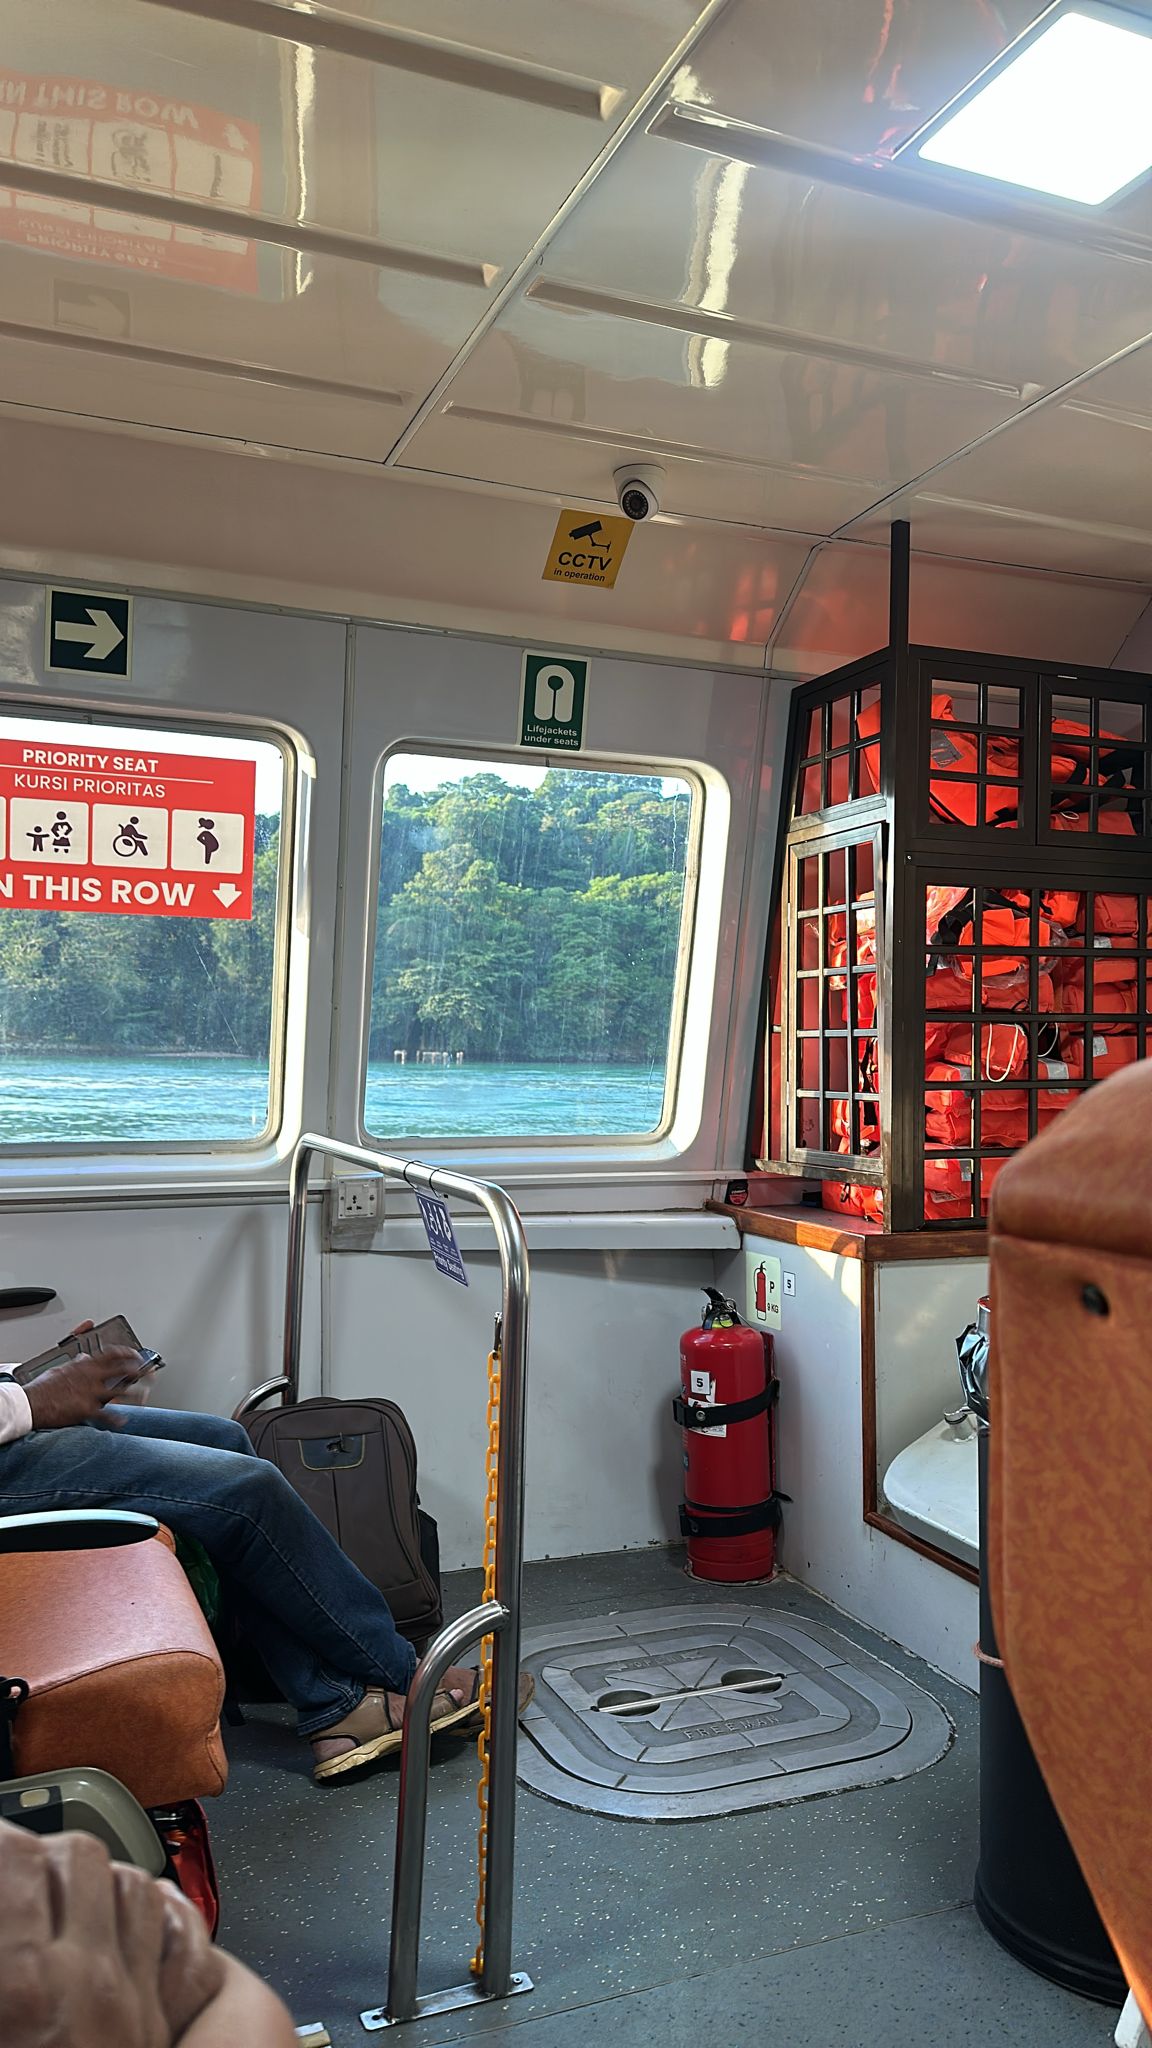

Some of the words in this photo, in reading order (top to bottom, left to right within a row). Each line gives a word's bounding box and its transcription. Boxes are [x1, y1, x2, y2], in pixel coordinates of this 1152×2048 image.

[558, 552, 612, 571] CCTV
[553, 568, 562, 576] in
[564, 570, 605, 582] operation
[527, 724, 578, 737] Lifejackets
[524, 735, 552, 744] under
[554, 738, 579, 747] seats
[22, 748, 109, 769] PRIORITY
[113, 756, 159, 773] SEAT
[14, 773, 68, 791] KURSI
[73, 777, 166, 798] PRIORITAS
[23, 874, 102, 902] THIS
[111, 879, 196, 907] ROW
[769, 1280, 775, 1293] P
[771, 1304, 779, 1314] KG
[683, 1713, 780, 1740] FREEMAN
